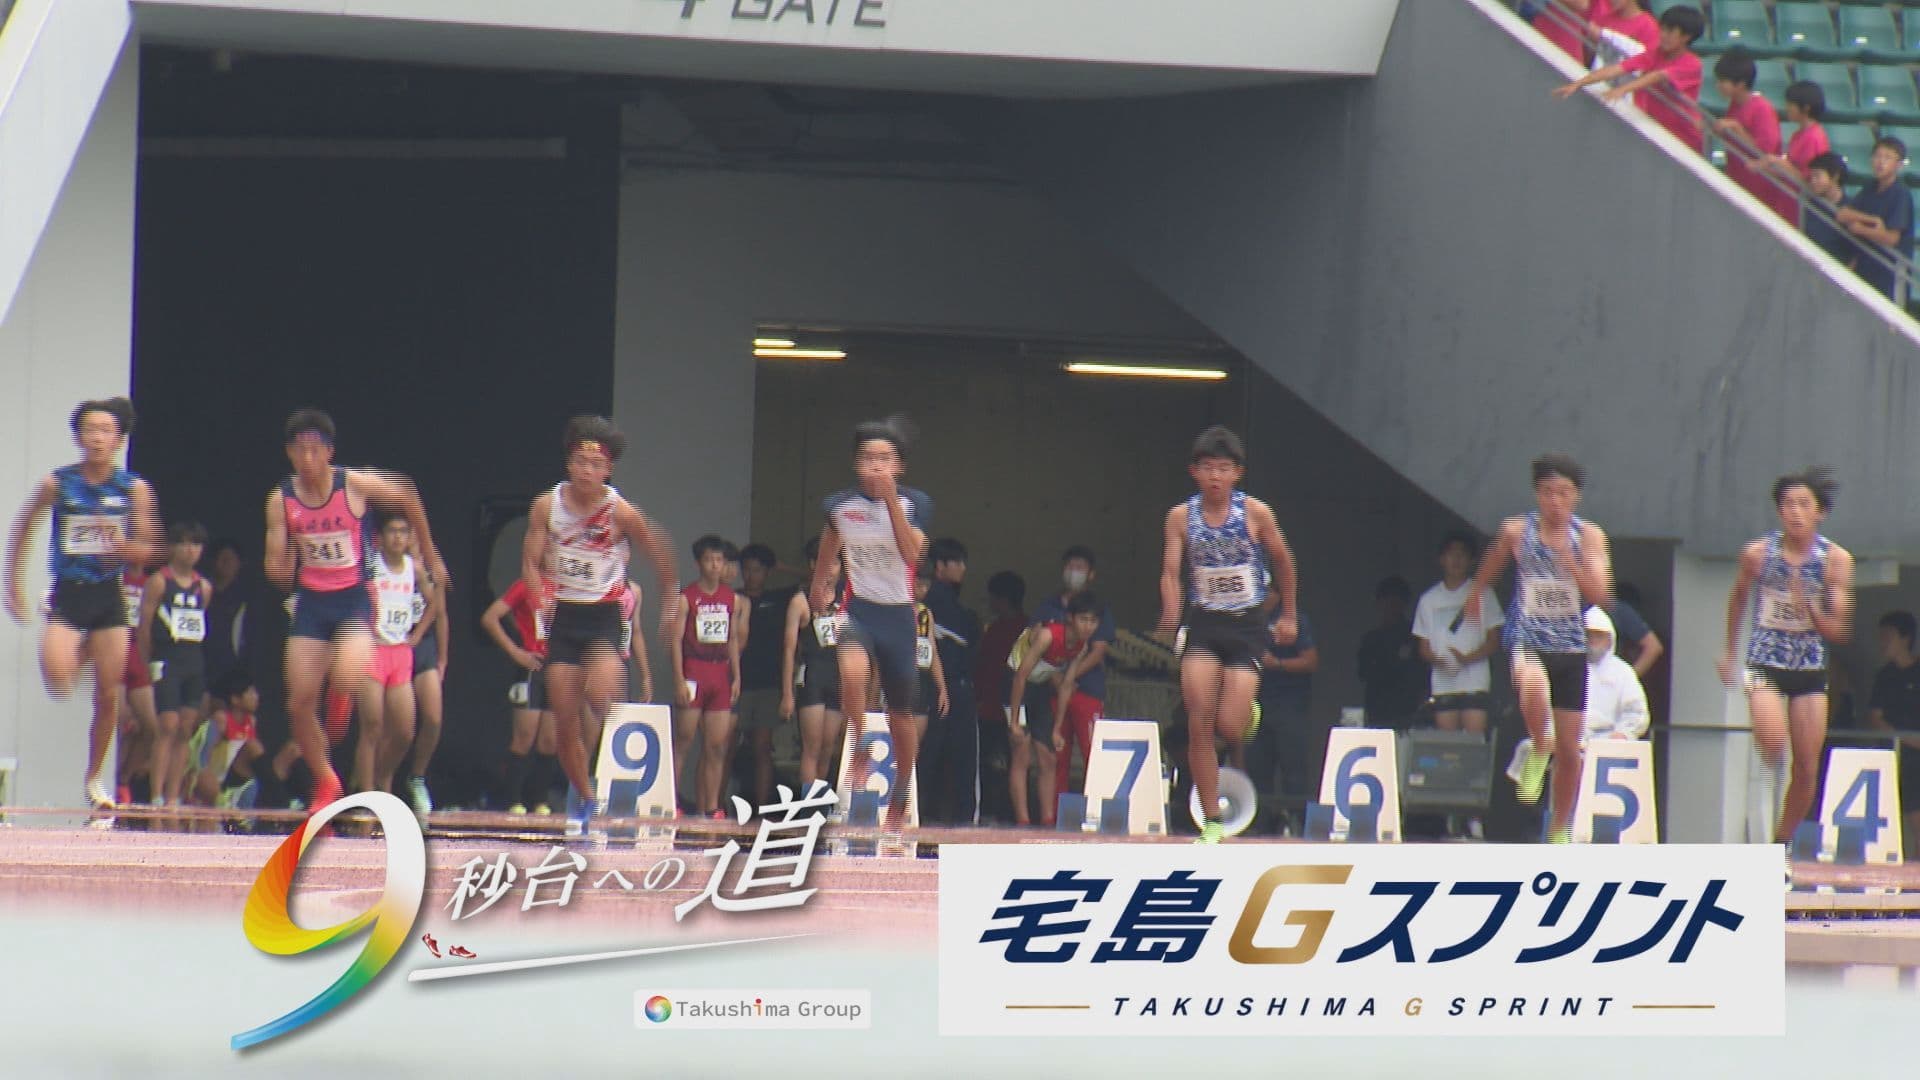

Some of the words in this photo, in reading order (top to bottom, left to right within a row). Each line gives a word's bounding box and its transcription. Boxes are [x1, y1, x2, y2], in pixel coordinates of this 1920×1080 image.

[304, 535, 345, 562] 241
[560, 556, 595, 580] 134
[387, 609, 409, 625] 187
[1208, 576, 1245, 594] 166
[704, 620, 728, 636] 227
[611, 722, 661, 797] 9
[857, 731, 897, 807] 8
[1102, 739, 1149, 803] 7
[1335, 746, 1384, 820] 6
[1594, 758, 1640, 832] 5
[1832, 769, 1888, 842] 4
